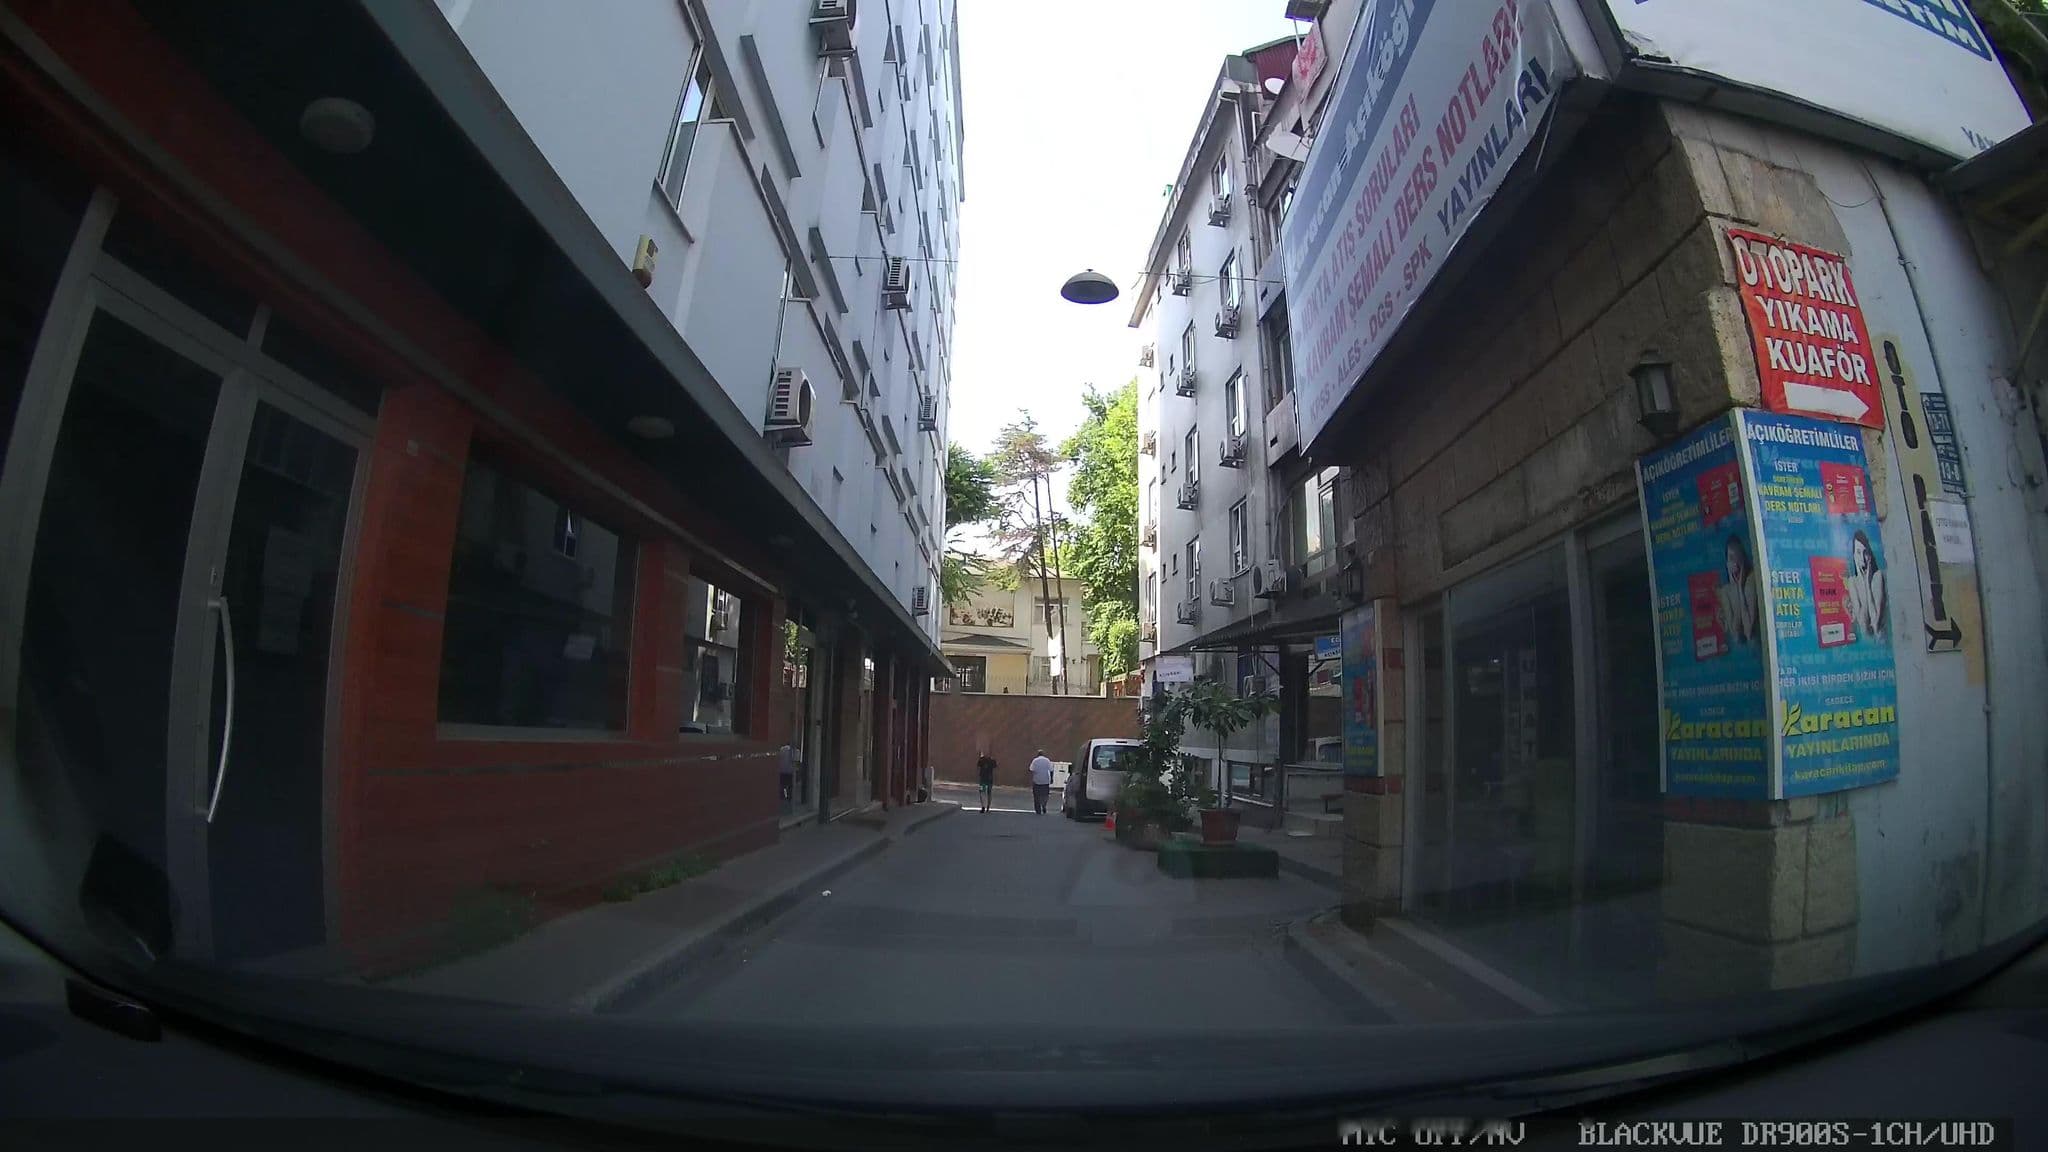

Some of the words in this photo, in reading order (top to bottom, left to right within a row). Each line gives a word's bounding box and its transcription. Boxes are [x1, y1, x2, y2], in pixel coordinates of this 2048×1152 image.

[1331, 220, 1356, 284] ATIŞ
[1355, 92, 1421, 239] SORULARI
[1337, 338, 1362, 384] ALES
[1369, 290, 1393, 342] DGS
[1403, 232, 1433, 291] SPK
[1437, 56, 1550, 237] YAYINLARI
[1347, 217, 1395, 328] ŞEMALI
[1394, 144, 1438, 242] DERS
[1733, 236, 1856, 307] OTOPARK
[1755, 295, 1860, 345] YIKAMA
[1765, 337, 1872, 386] KUAFÖR
[1746, 421, 1859, 451] AÇIKÖĞRETİMLİLER
[1775, 459, 1798, 472] İSTER
[1771, 570, 1800, 584] STER
[1776, 603, 1800, 618] ATIŞ
[1781, 699, 1895, 736] Karacan
[1787, 732, 1890, 757] YAYINLARINDA
